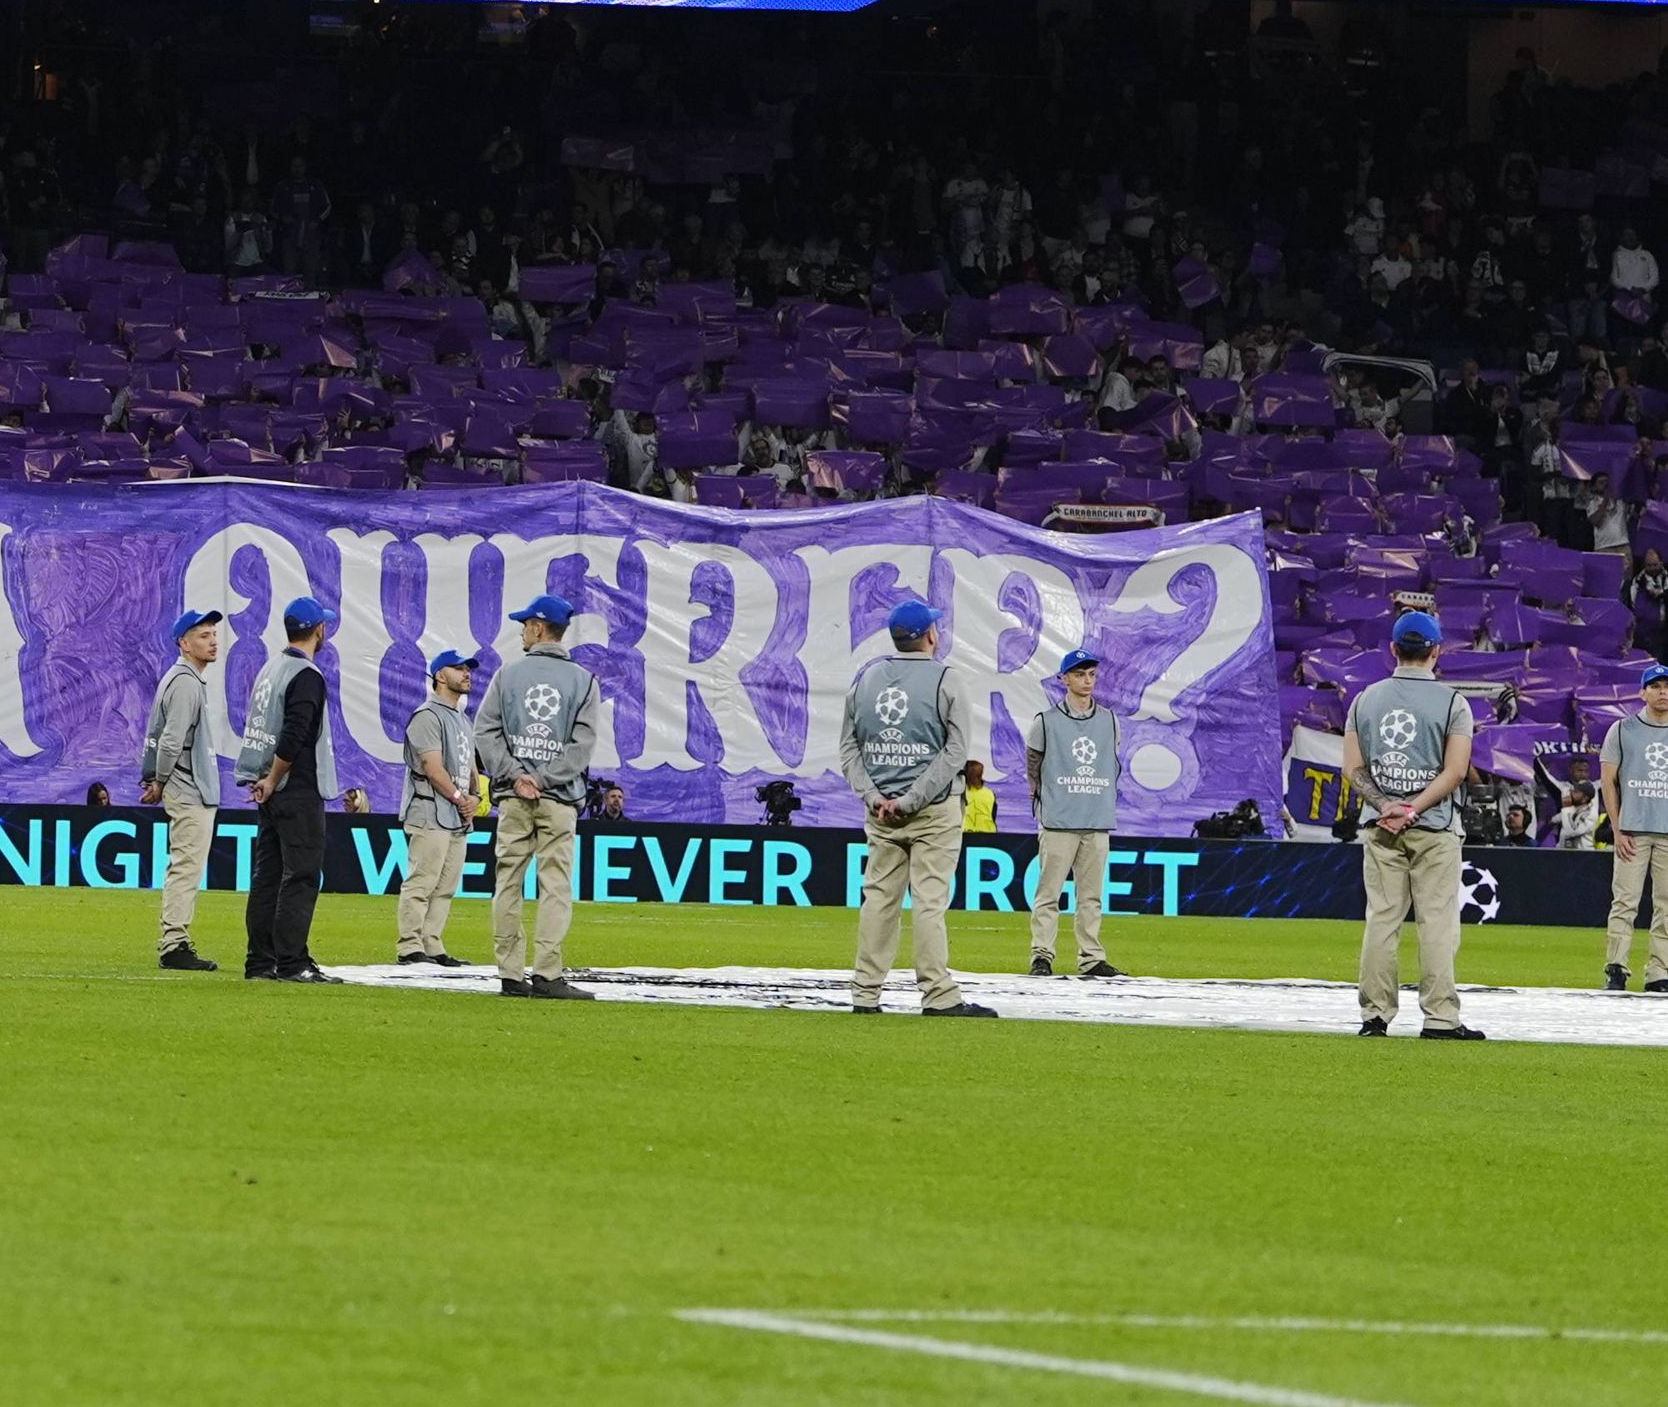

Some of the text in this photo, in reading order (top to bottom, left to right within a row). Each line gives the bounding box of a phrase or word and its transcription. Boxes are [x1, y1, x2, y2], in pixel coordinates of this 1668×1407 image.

[180, 520, 1266, 792] QUERER?
[527, 723, 553, 738] UEFA
[879, 728, 905, 743] UEFA
[509, 734, 564, 754] HAMPION
[871, 754, 917, 767] LEAGUE
[1383, 751, 1409, 767] UEFA
[1370, 765, 1438, 780] AMPIONS
[1057, 776, 1110, 787] CHAMPIONS
[1067, 785, 1102, 795] LEAGUE
